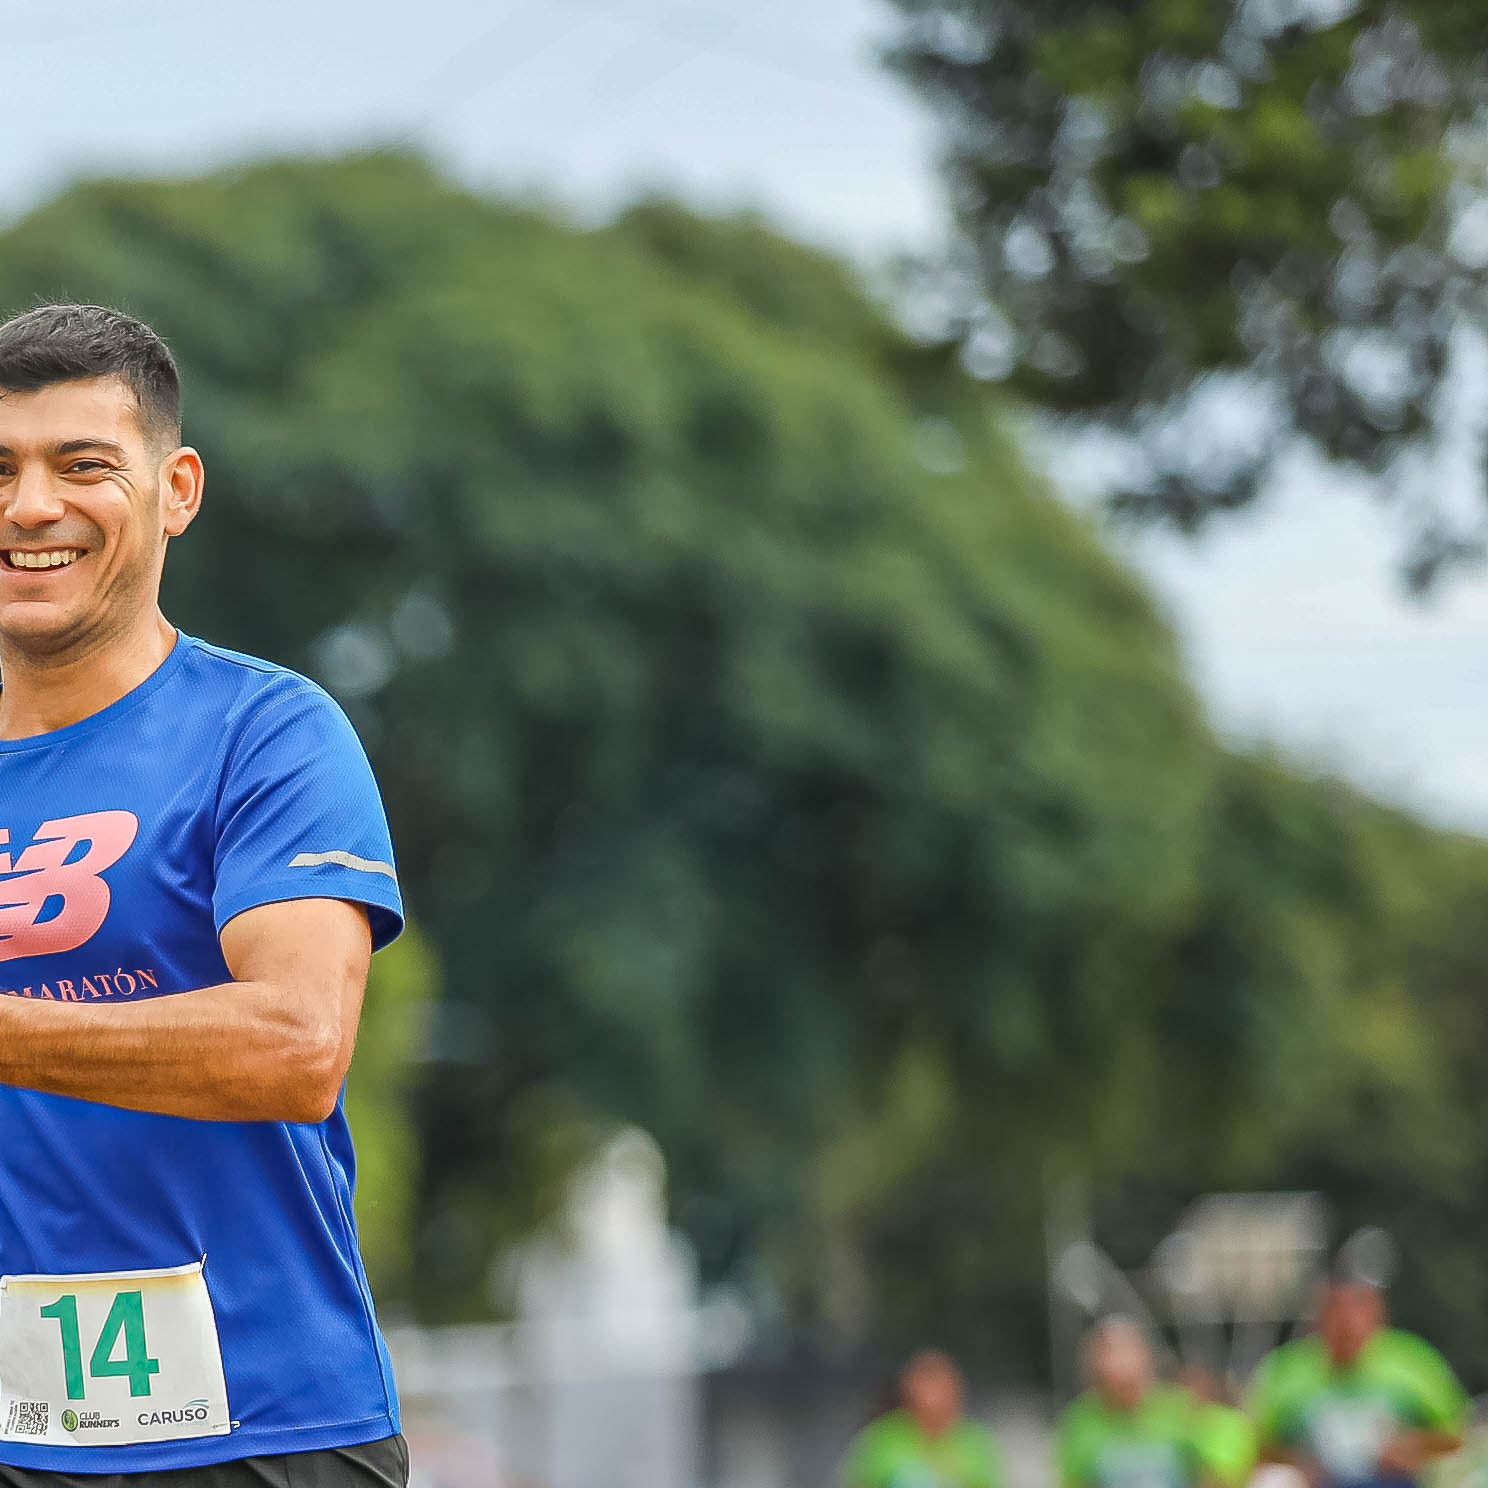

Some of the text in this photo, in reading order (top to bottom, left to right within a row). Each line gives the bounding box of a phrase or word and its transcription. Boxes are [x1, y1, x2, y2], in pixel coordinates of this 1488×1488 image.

[39, 1290, 160, 1400] 14
[79, 1411, 101, 1421] CLUB
[137, 1407, 208, 1426] CARUSO
